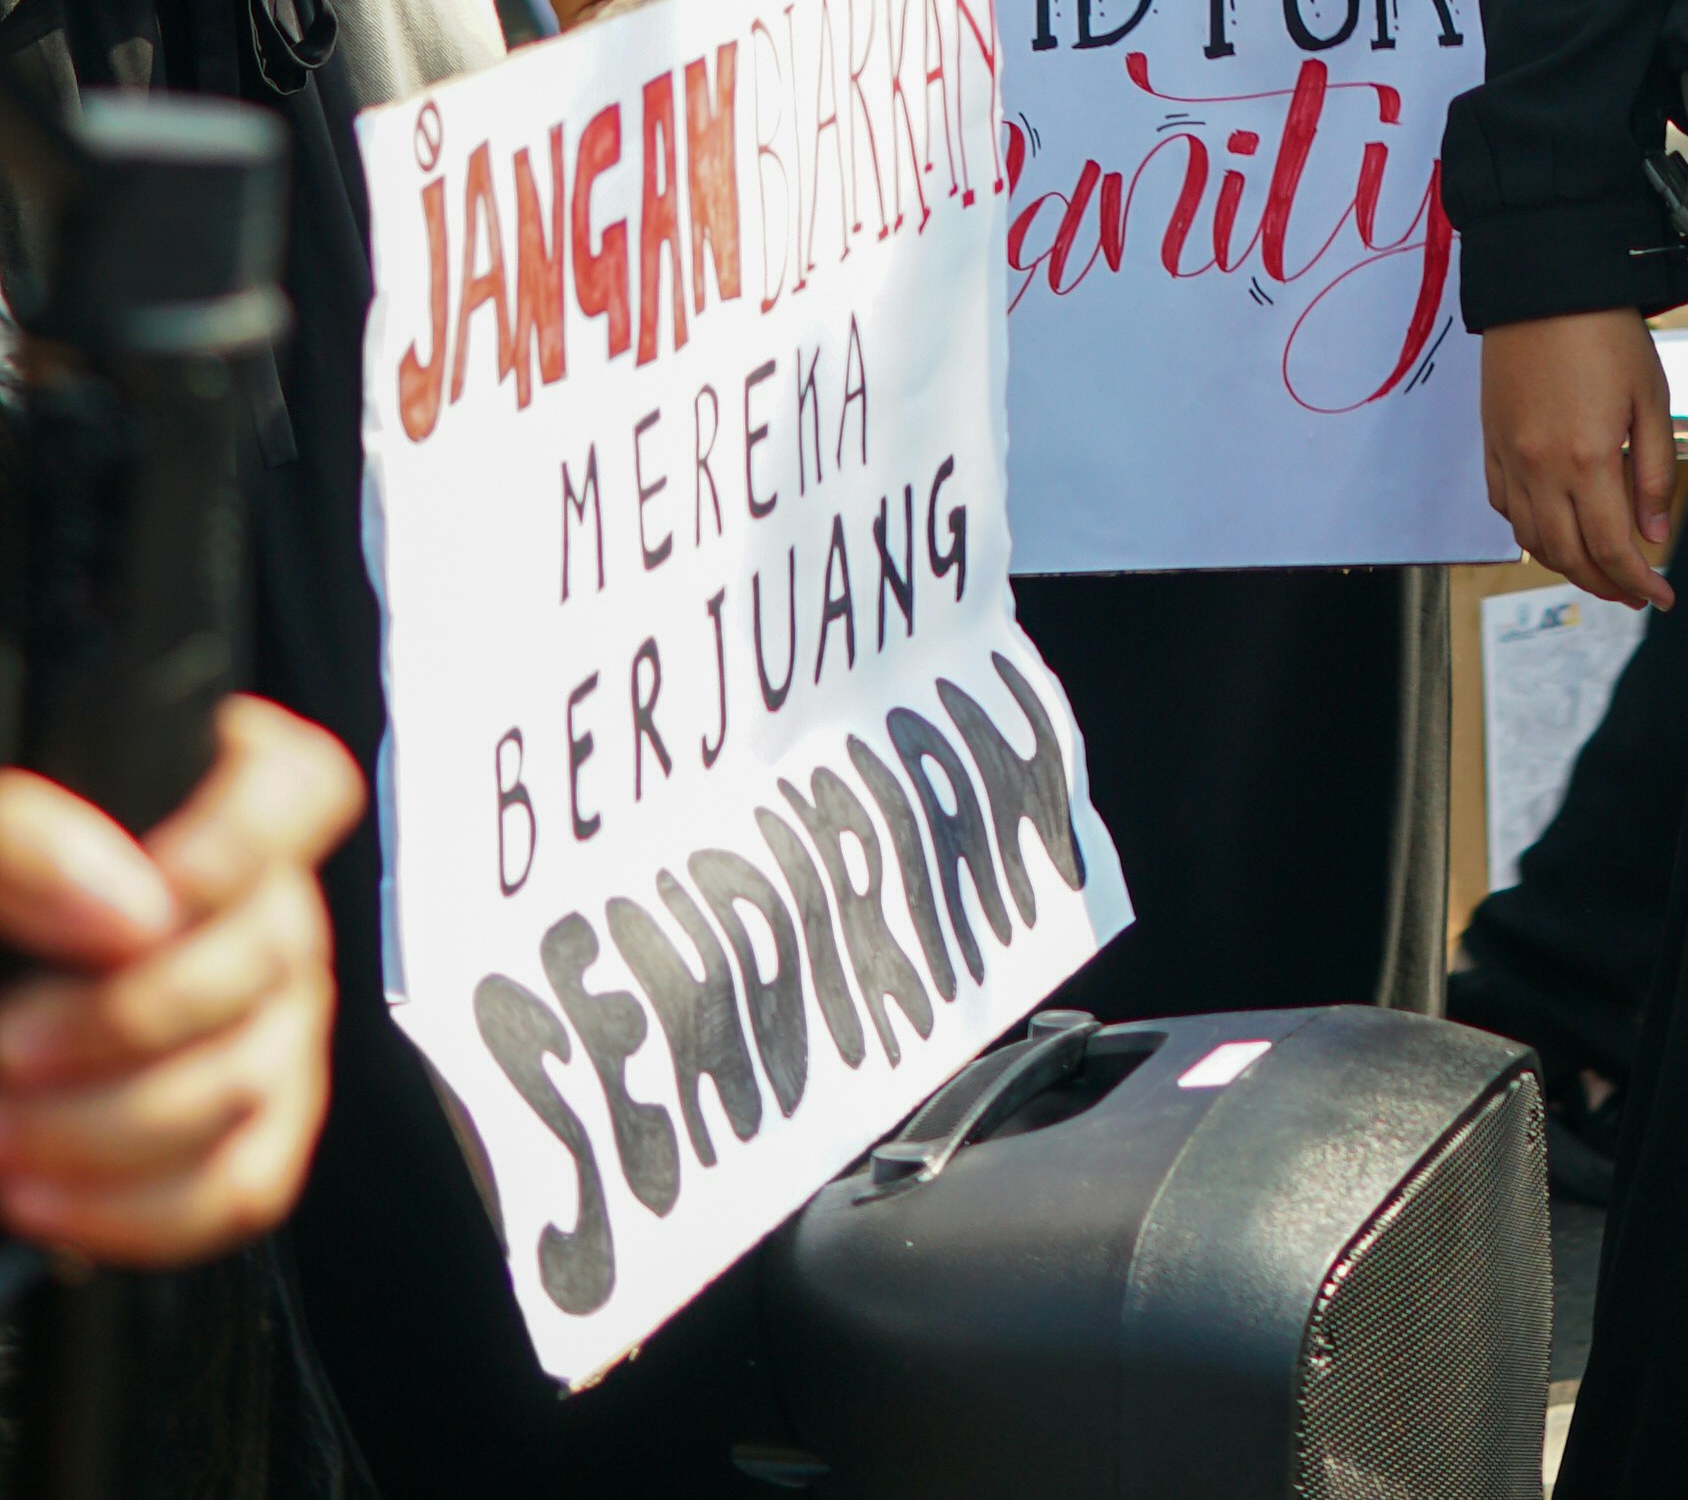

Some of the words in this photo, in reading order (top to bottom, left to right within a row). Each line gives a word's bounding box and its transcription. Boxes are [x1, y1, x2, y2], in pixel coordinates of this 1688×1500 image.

[495, 453, 967, 898] BERJUANG
[561, 311, 868, 605] MEREKA
[472, 650, 1087, 1317] SENDIRIAN
